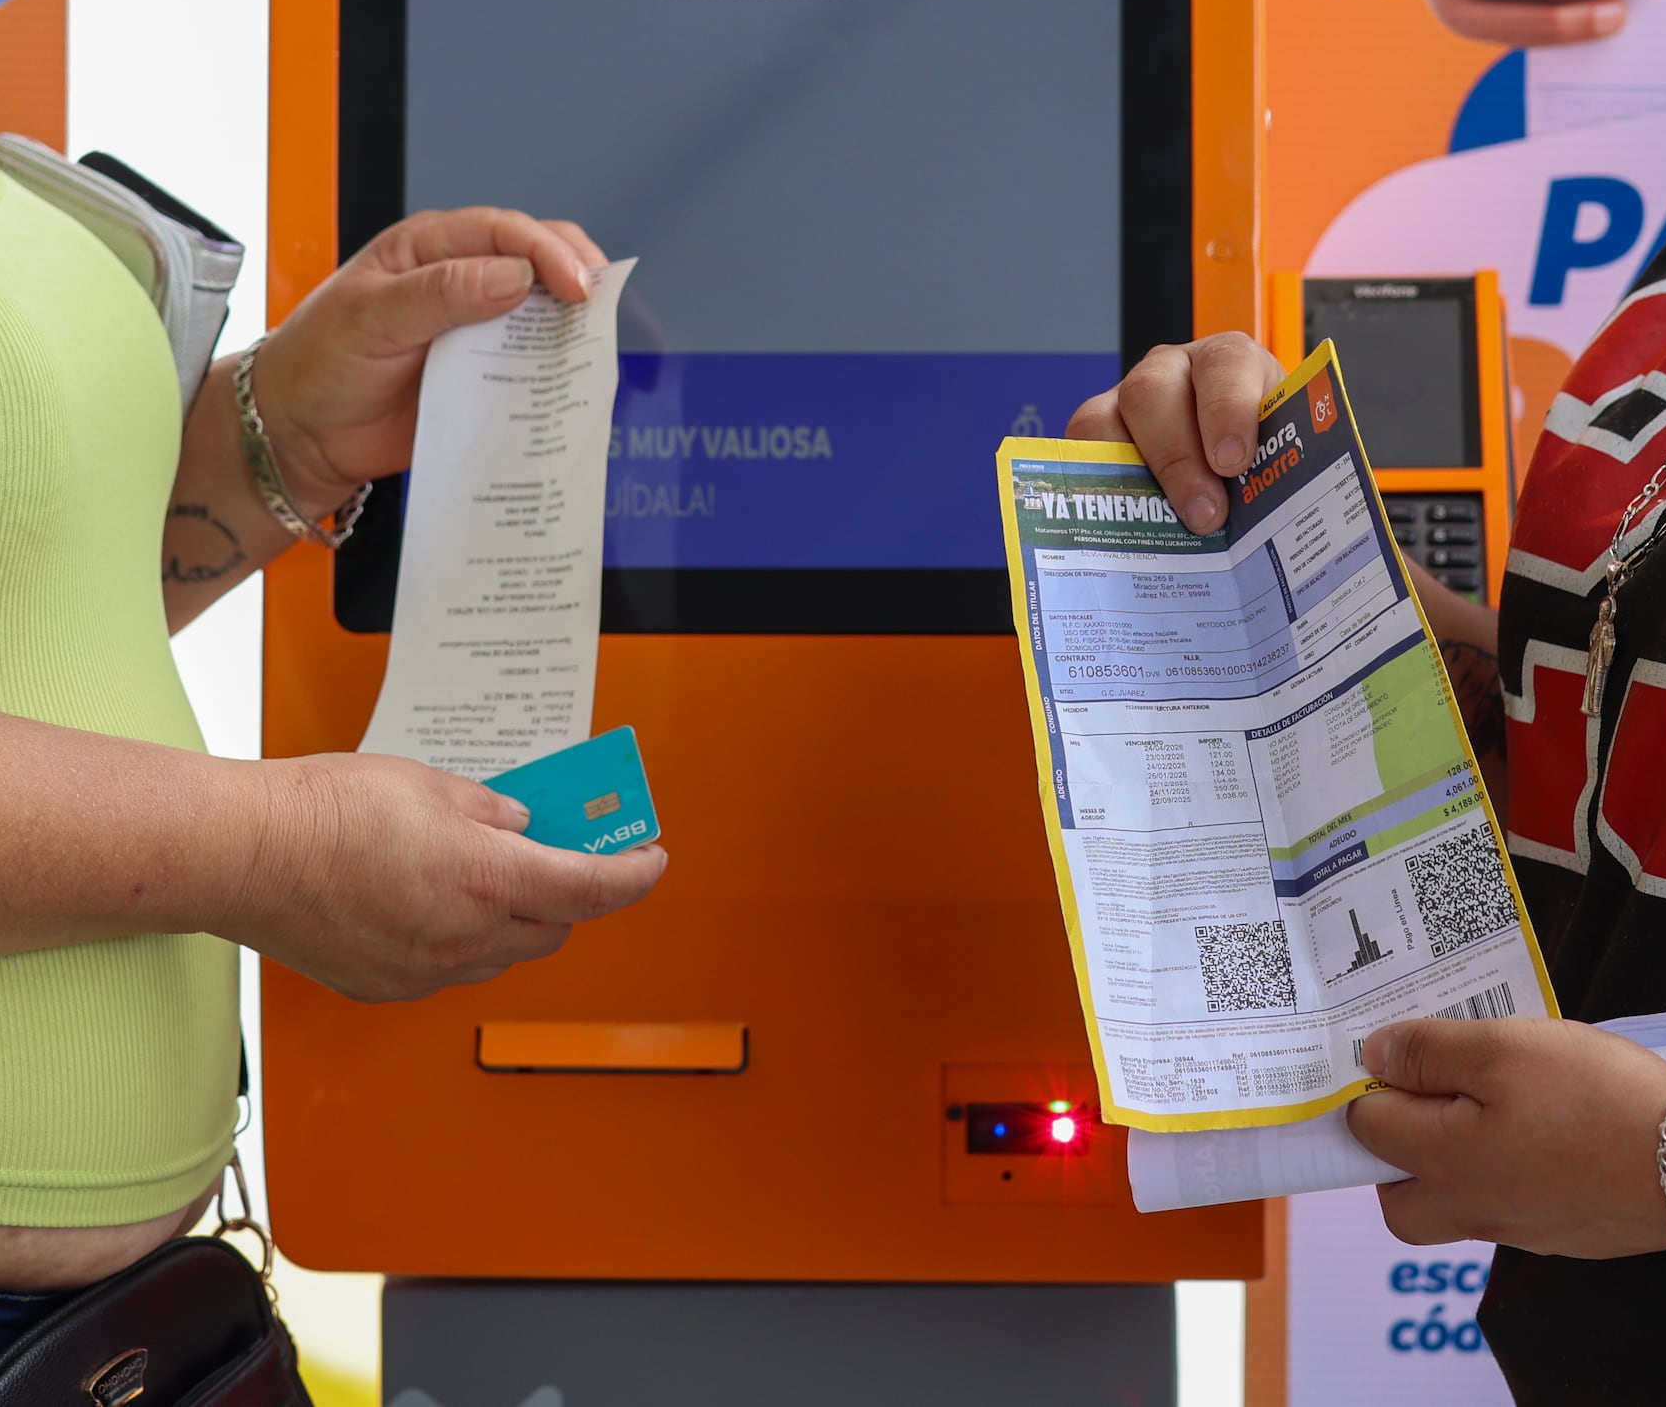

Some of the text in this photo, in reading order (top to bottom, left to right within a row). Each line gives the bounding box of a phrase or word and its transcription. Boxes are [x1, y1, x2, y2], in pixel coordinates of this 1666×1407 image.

[630, 427, 832, 458] MUY VALIOSA
[605, 481, 715, 519] UÍDALA!
[1041, 492, 1178, 523] YA TENEMOS
[1074, 536, 1101, 544] PERSONA
[1102, 536, 1123, 544] MORAL
[1165, 539, 1202, 547] LUCRATIVOS
[1028, 580, 1038, 610] TITULAR
[1035, 626, 1043, 651] DATOS
[1055, 654, 1096, 662] CONTRATO
[1068, 662, 1145, 679] 610853601
[1042, 695, 1056, 734] CONSUMO
[1251, 721, 1282, 740] DETALLE
[1291, 692, 1334, 725] FACTURACIÓN
[1446, 759, 1474, 777] 128.00
[1055, 769, 1067, 800] ADEUDO
[1445, 775, 1479, 798] 4,061.00
[583, 818, 648, 853] BBVA
[1308, 827, 1327, 844] TOTAL
[1339, 813, 1352, 828] MES
[1328, 829, 1357, 850] ADEUDO
[1313, 864, 1332, 882] TOTAL
[1339, 849, 1363, 866] PAGAR
